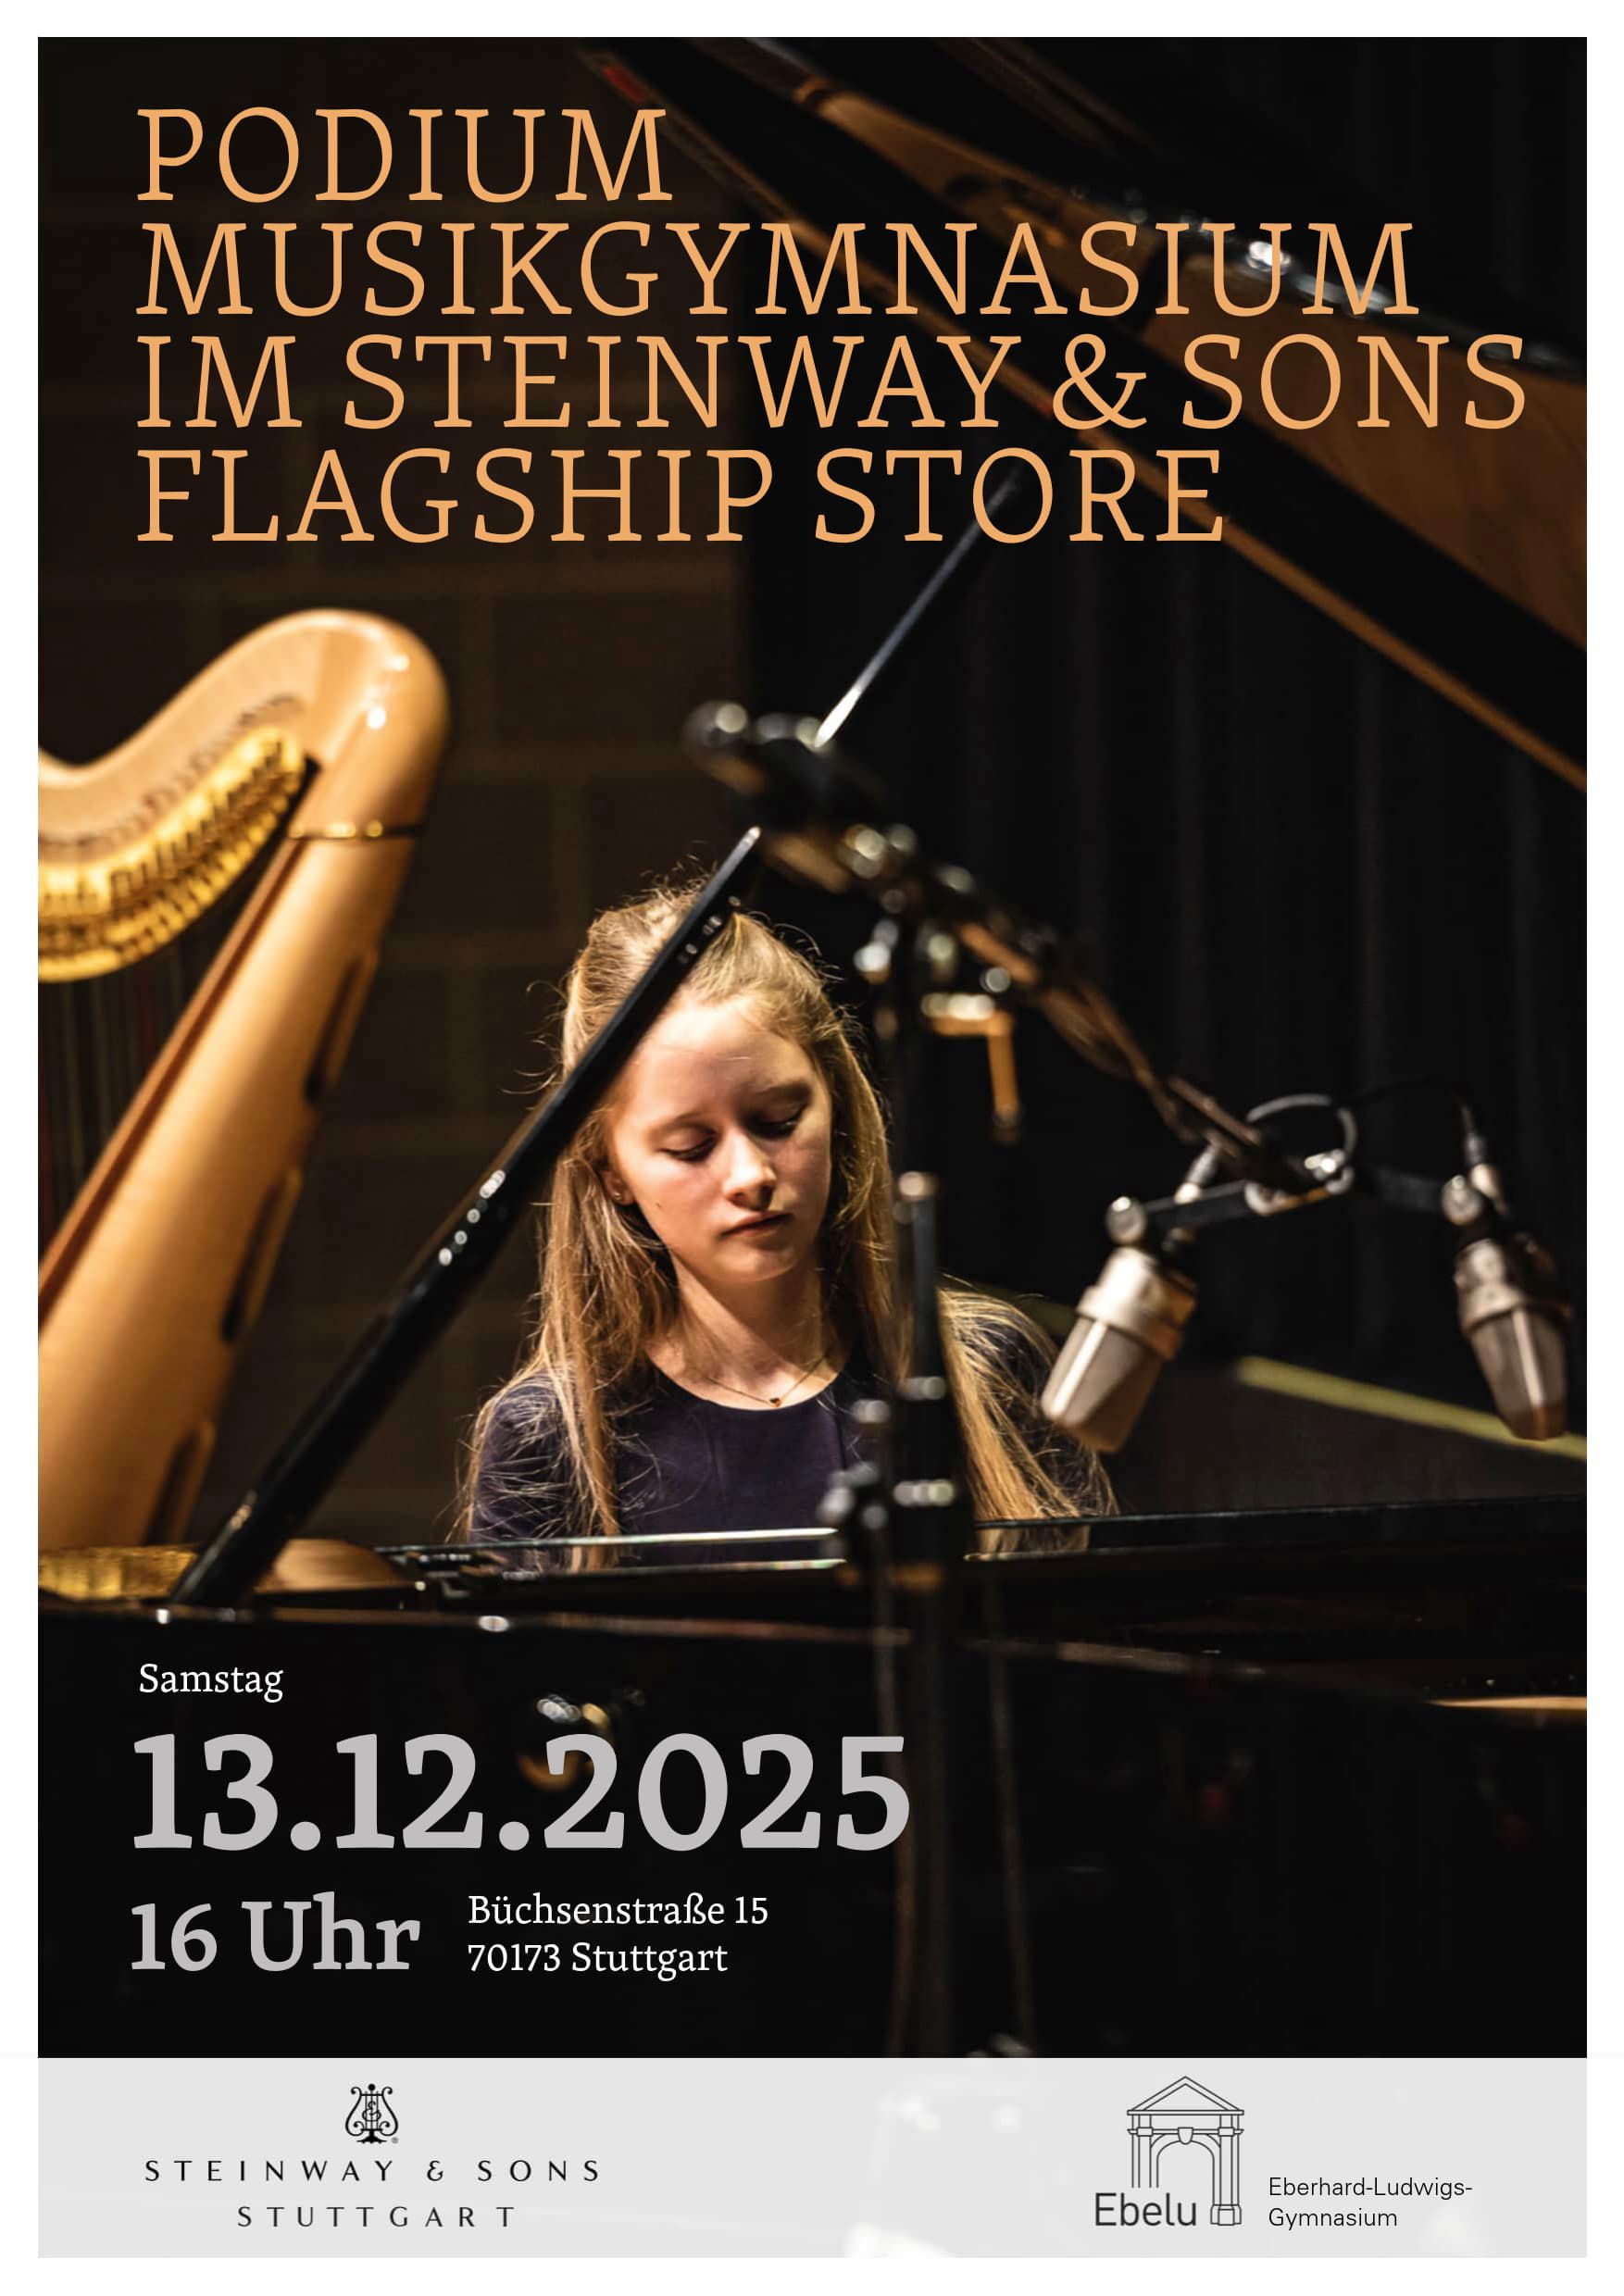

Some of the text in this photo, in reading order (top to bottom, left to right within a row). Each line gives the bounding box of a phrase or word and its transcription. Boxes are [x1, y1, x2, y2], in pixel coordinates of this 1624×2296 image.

[137, 106, 673, 203] PODIUM
[135, 220, 1419, 317] MUSIKGYMNASIUM
[137, 333, 1525, 430] IM STEINWAY & SONS
[137, 447, 1223, 543] FLAGSHIP STORE
[139, 1663, 284, 1703] Samstag
[133, 1732, 910, 1852] 13.12.2025
[468, 1891, 768, 1925] Büchsenstraße 15
[131, 1890, 420, 1972] 16 Uhr
[468, 1941, 729, 1982] 70173 Stuttgart
[144, 2159, 598, 2182] STEINWAY & SONS
[1269, 2177, 1473, 2201] Eberhard-Ludwigs-
[237, 2205, 515, 2227] STUTTGART
[1094, 2191, 1197, 2227] Ebelu
[1268, 2207, 1397, 2231] Gymnasium
